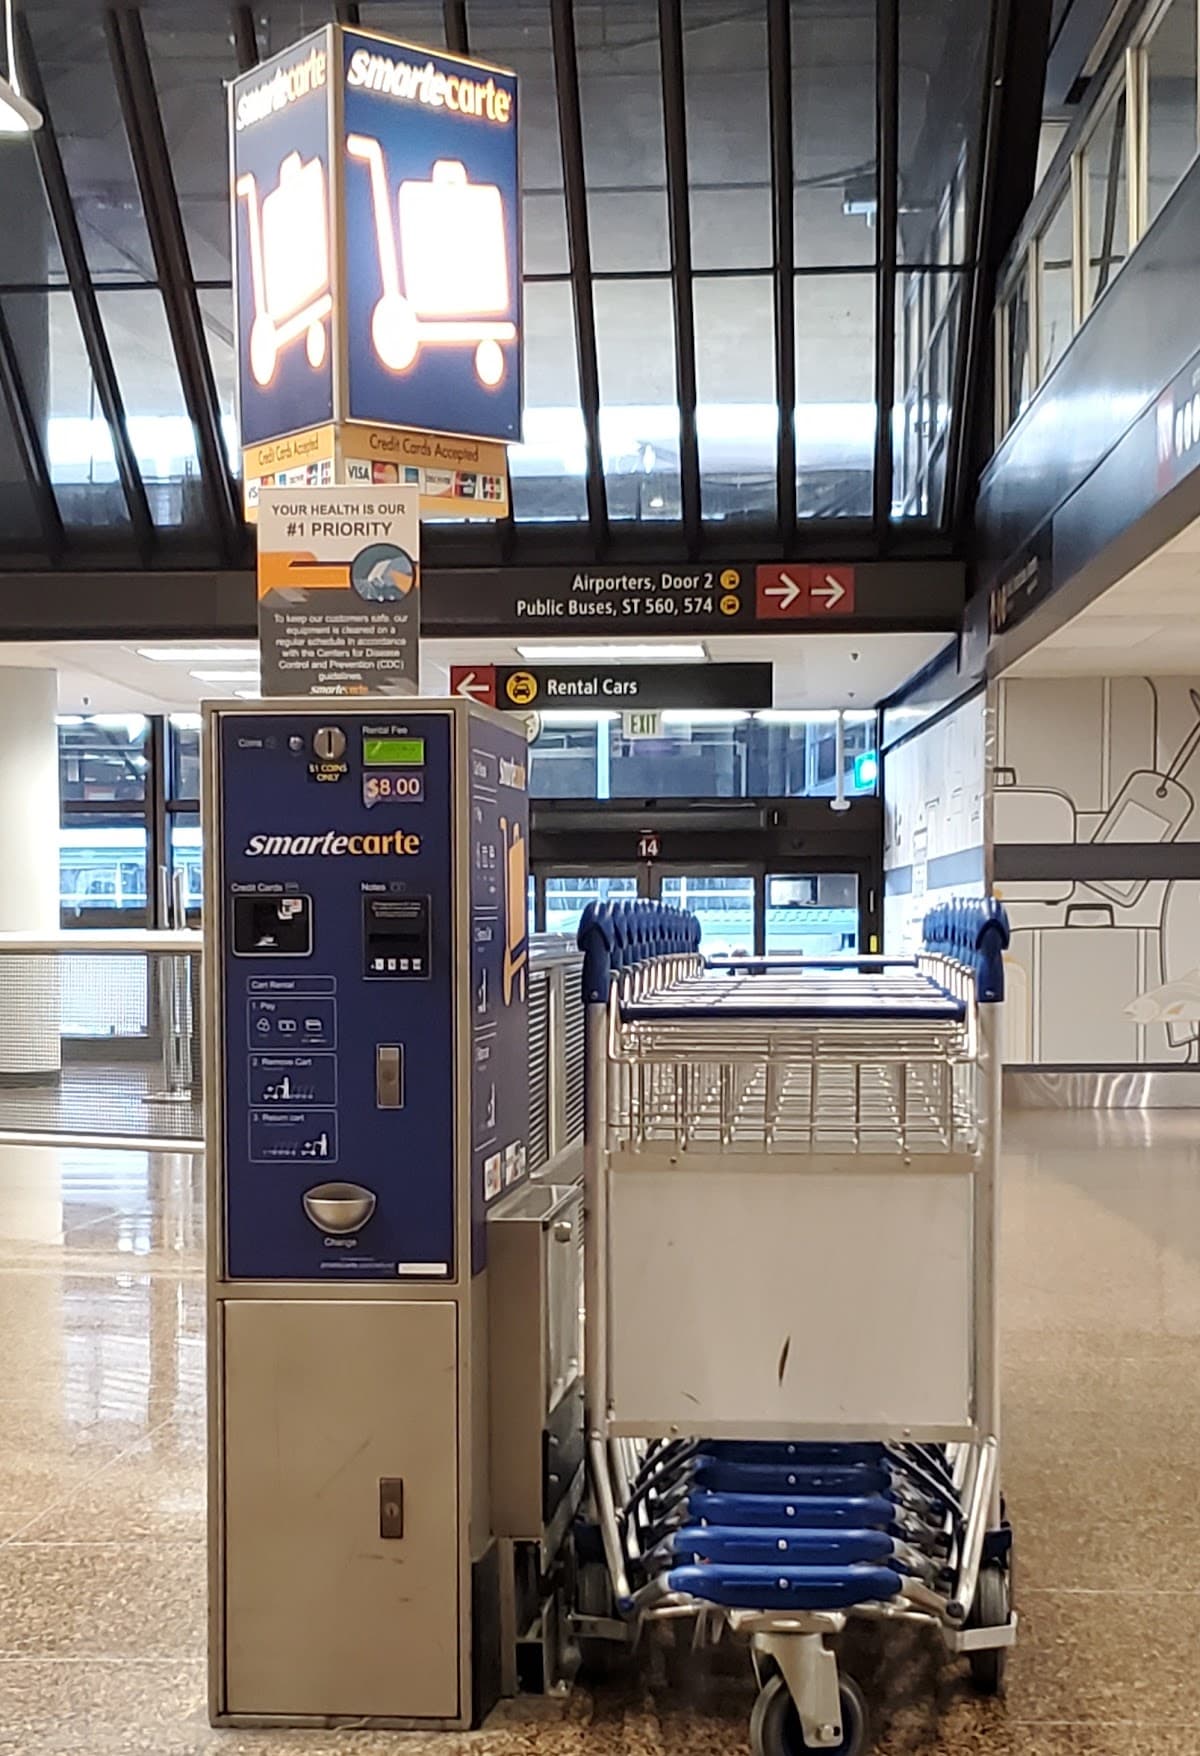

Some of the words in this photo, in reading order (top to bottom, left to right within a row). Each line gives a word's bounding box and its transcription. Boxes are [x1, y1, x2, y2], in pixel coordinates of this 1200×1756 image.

[236, 48, 327, 130] smartecarte
[347, 49, 512, 123] smartecarte
[369, 433, 400, 452] Credit
[402, 438, 431, 457] Cards
[434, 442, 479, 464] Accepted
[348, 465, 370, 480] VISA
[272, 504, 307, 516] YOUR
[311, 504, 360, 516] HEALTH
[363, 503, 374, 515] IS
[378, 503, 406, 515] OUR
[287, 523, 305, 537] #1
[311, 522, 393, 537] PRIORITY
[572, 574, 656, 592] Airporters,
[661, 574, 701, 589] Door
[703, 573, 713, 588] 2
[516, 600, 565, 616] Public
[568, 600, 617, 617] Buses,
[622, 599, 640, 614] ST
[645, 599, 679, 617] 560,
[683, 598, 713, 614] 574
[274, 613, 284, 623] To
[286, 613, 308, 624] keep
[309, 615, 323, 623] our
[325, 614, 369, 623] customers
[393, 614, 408, 623] our
[286, 626, 330, 637] equipment
[332, 626, 340, 635] is
[341, 626, 375, 635] cleaned
[377, 627, 388, 635] on
[275, 638, 305, 648] regular
[307, 637, 346, 646] schedule
[281, 648, 299, 657] with
[301, 648, 315, 657] the
[317, 648, 350, 658] Centers
[352, 648, 363, 657] for
[366, 648, 400, 657] Disease
[279, 659, 309, 669] Control
[311, 659, 327, 669] and
[329, 659, 375, 669] Prevention
[376, 659, 405, 671] (CDC)
[547, 679, 598, 695] Rental
[602, 679, 638, 695] Cars
[630, 713, 657, 735] EXIT
[362, 726, 388, 735] Rental
[391, 726, 408, 735] Fee
[320, 764, 347, 773] COINS
[316, 773, 340, 782] ONLY
[367, 778, 420, 798] $8.00
[245, 831, 421, 856] smartecarte
[639, 839, 660, 857] 14
[231, 882, 256, 892] Credit
[257, 882, 283, 892] Cards
[361, 882, 386, 892] Notes
[260, 1001, 276, 1011] Pay
[294, 1057, 312, 1066] Cart
[323, 1236, 357, 1248] Change
